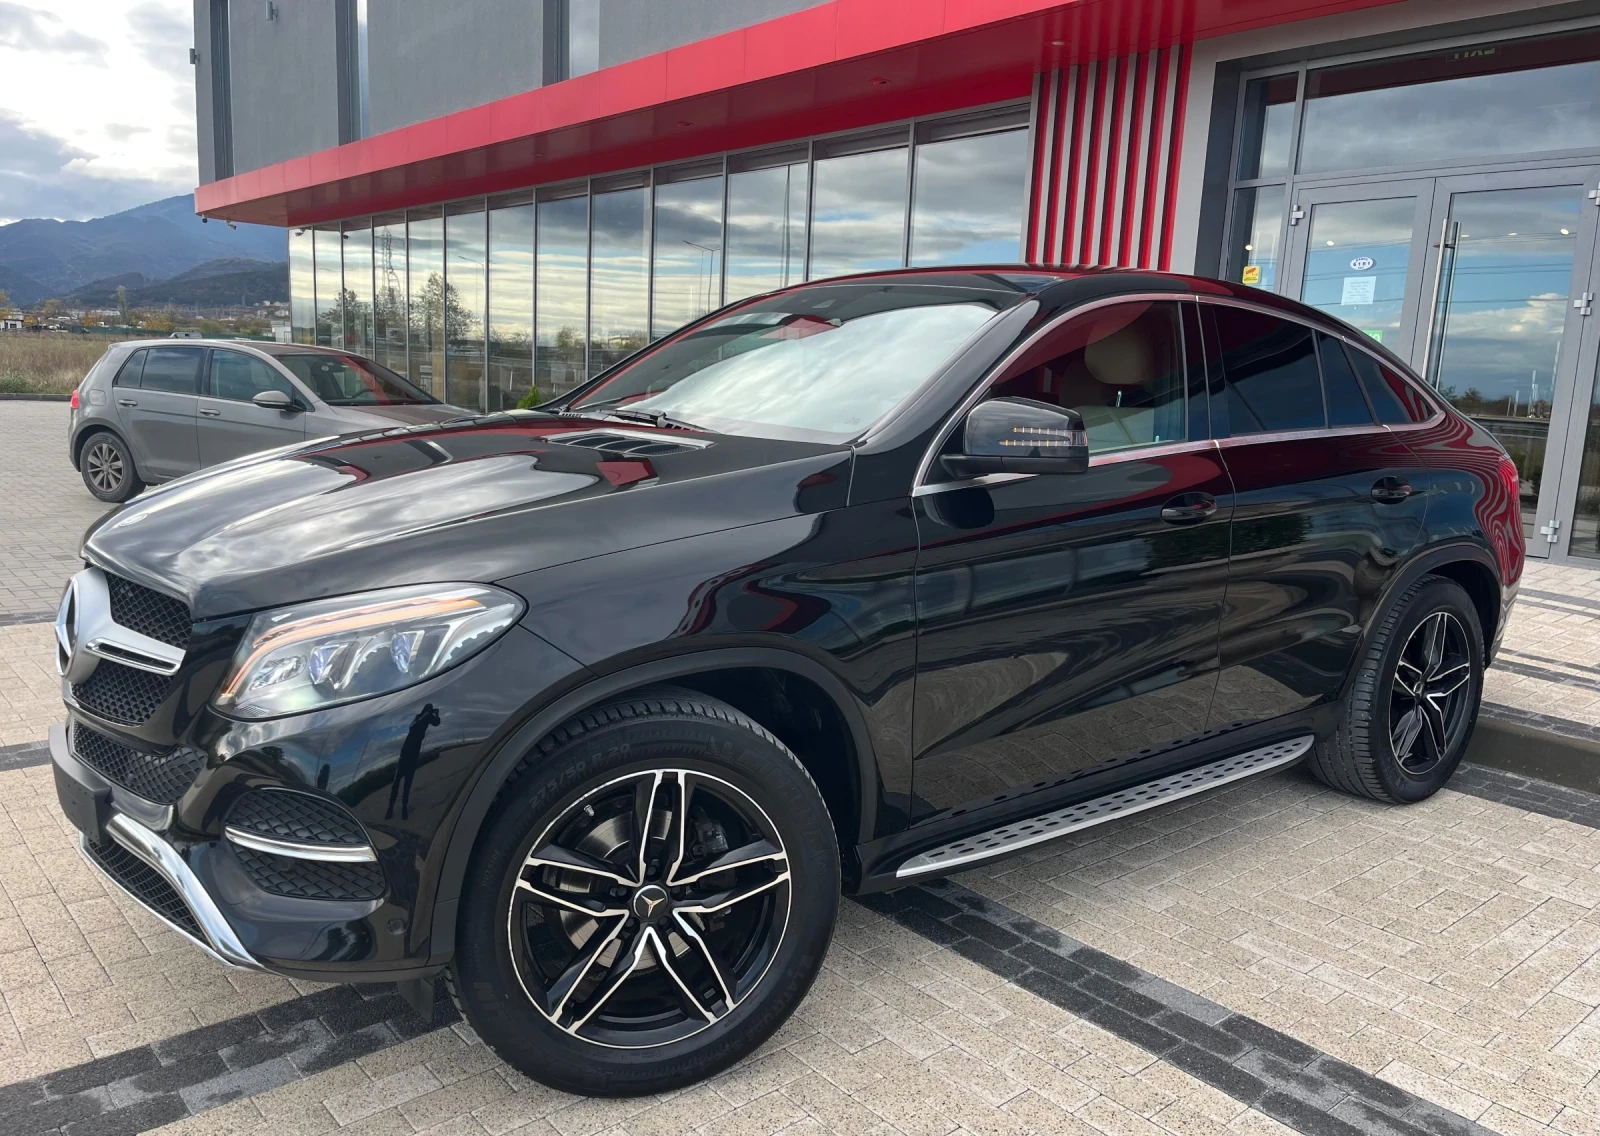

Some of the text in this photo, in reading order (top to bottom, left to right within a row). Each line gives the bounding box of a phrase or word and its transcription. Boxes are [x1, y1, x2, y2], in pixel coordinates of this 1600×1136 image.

[528, 742, 630, 809] 275/50 R 20
[480, 847, 500, 887] OUTSIDE
